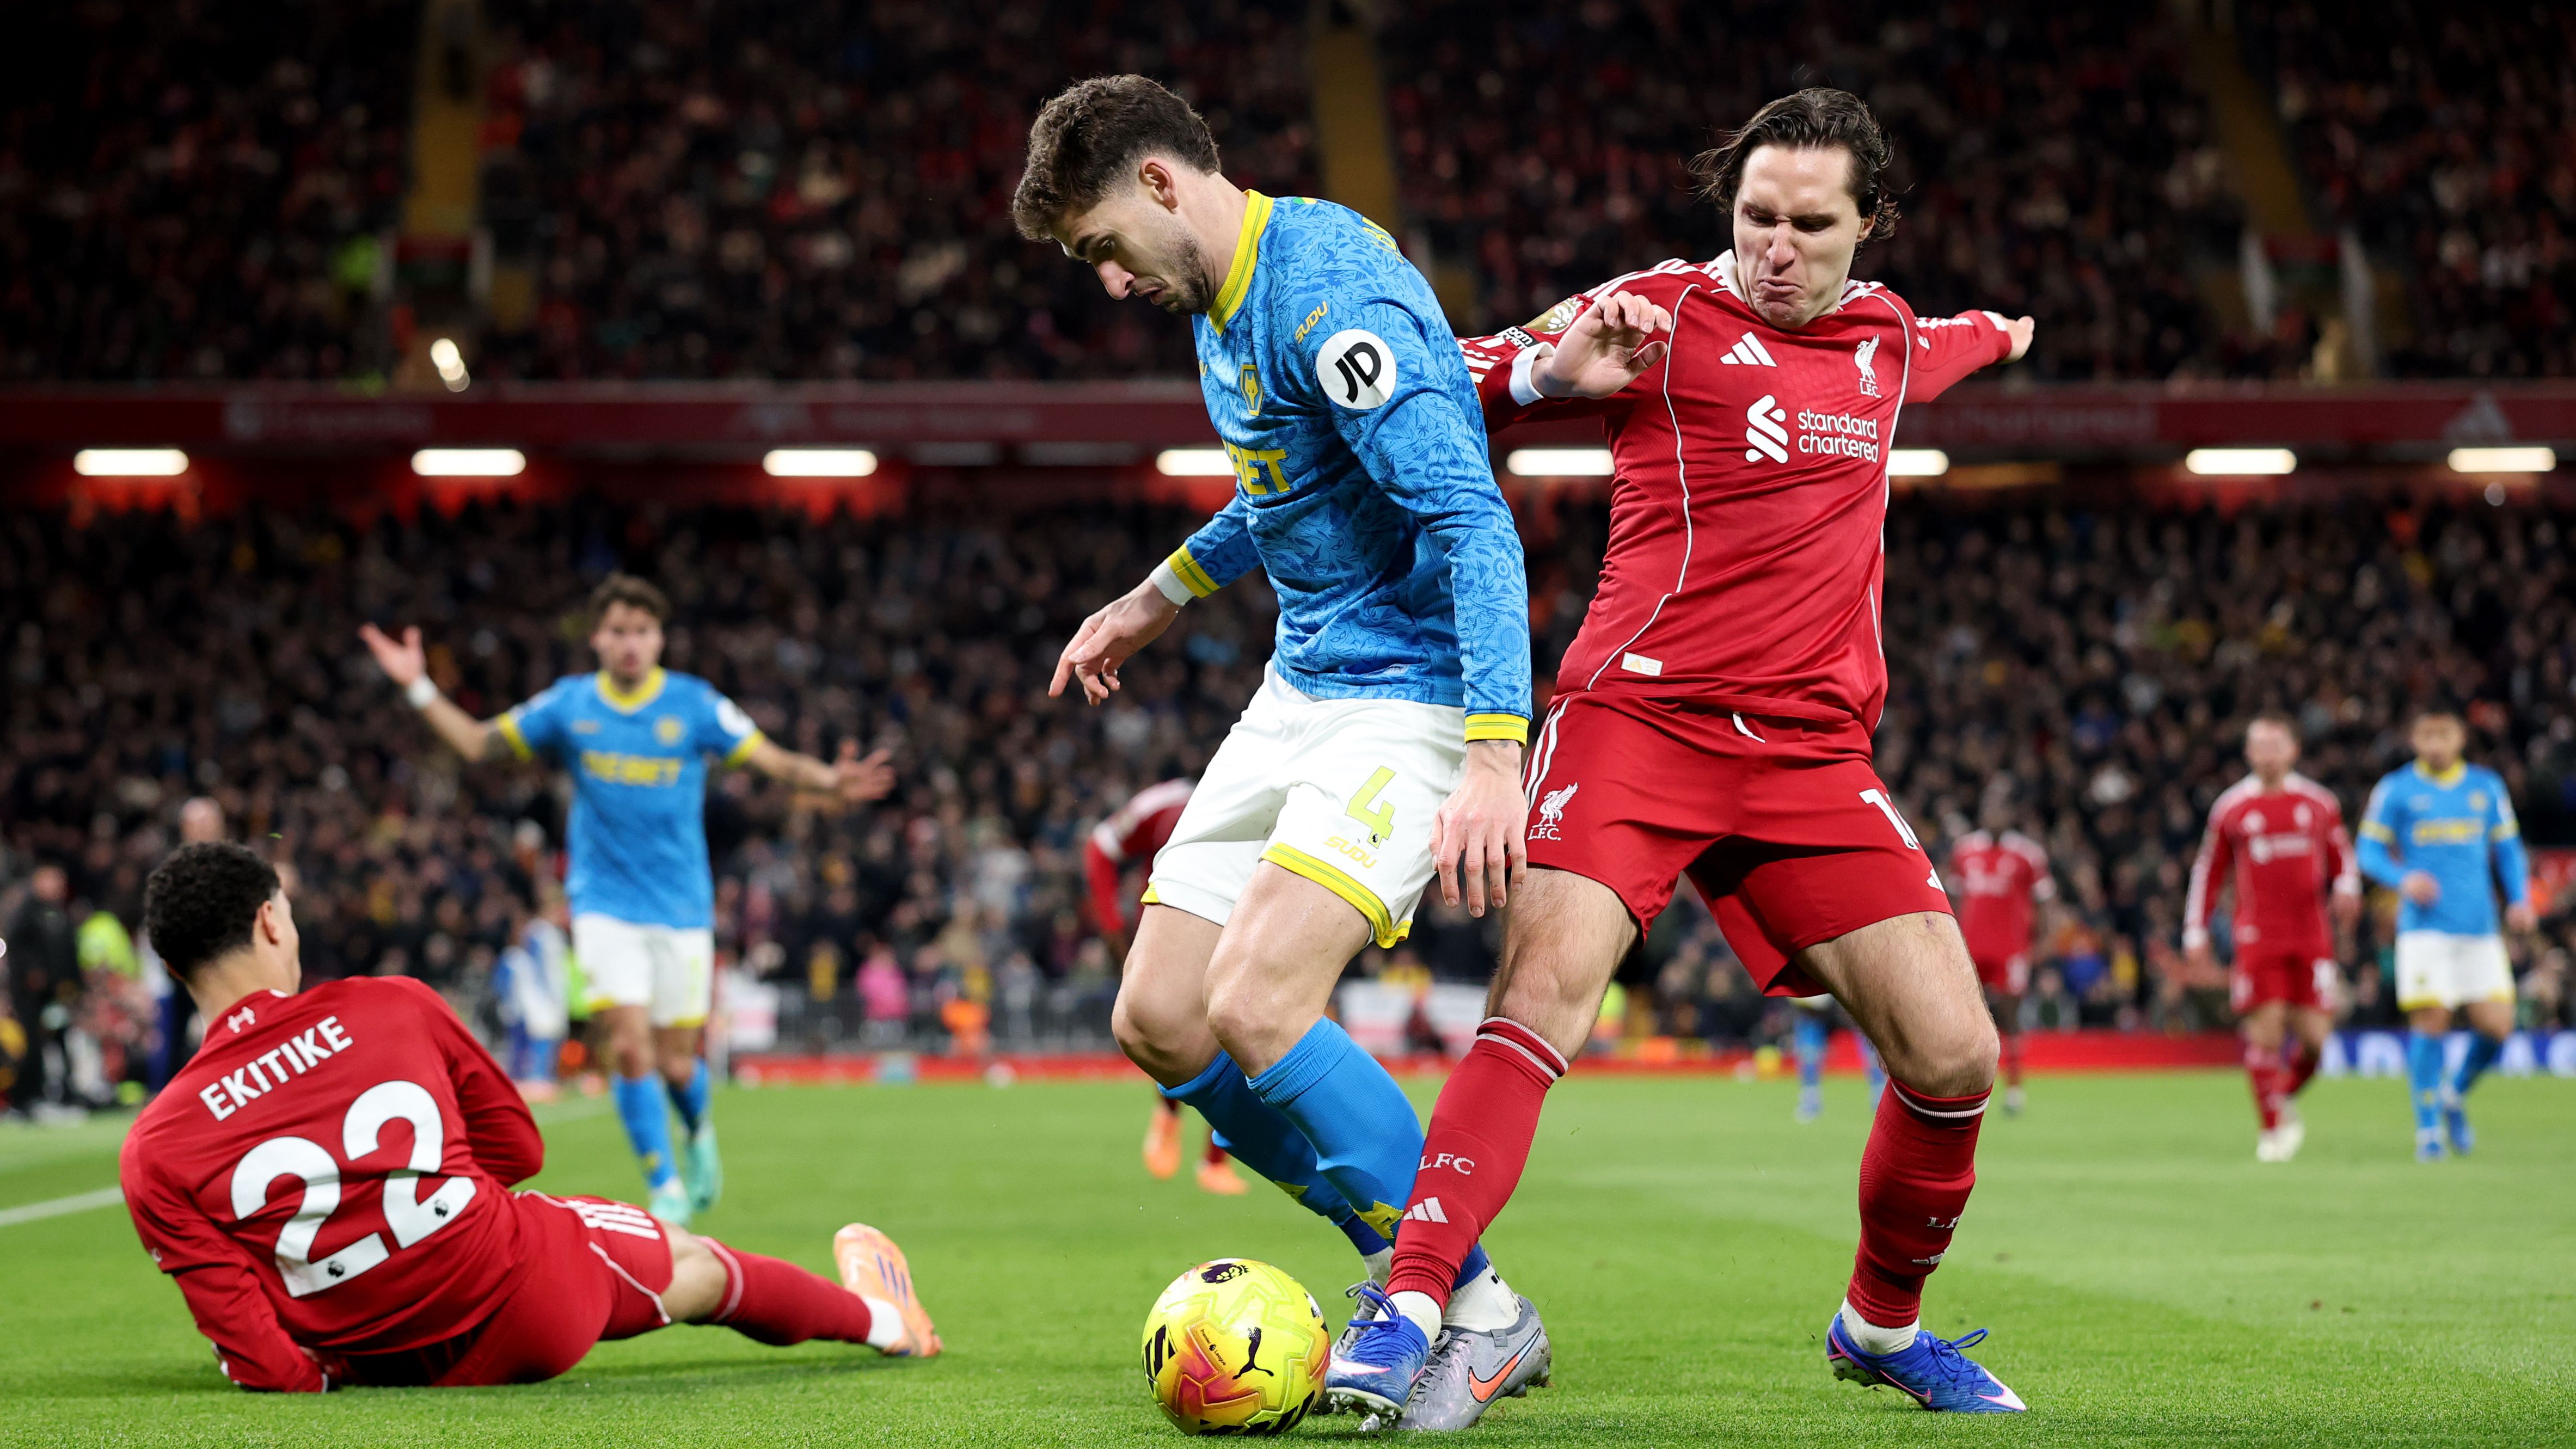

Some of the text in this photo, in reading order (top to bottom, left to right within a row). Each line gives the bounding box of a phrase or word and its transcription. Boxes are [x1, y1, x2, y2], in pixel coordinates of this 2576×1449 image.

[1295, 300, 1328, 344] SUDU
[1335, 342, 1381, 403] JD
[1798, 408, 1878, 440] standard
[1798, 431, 1879, 463] chartered
[1345, 765, 1396, 849] 4
[1859, 788, 1919, 850] 1
[1323, 836, 1377, 869] SUDU
[199, 1016, 353, 1121] EKITIKE
[1418, 1152, 1475, 1175] LFC
[230, 1080, 477, 1299] 22
[1200, 1328, 1226, 1366] Premier League
